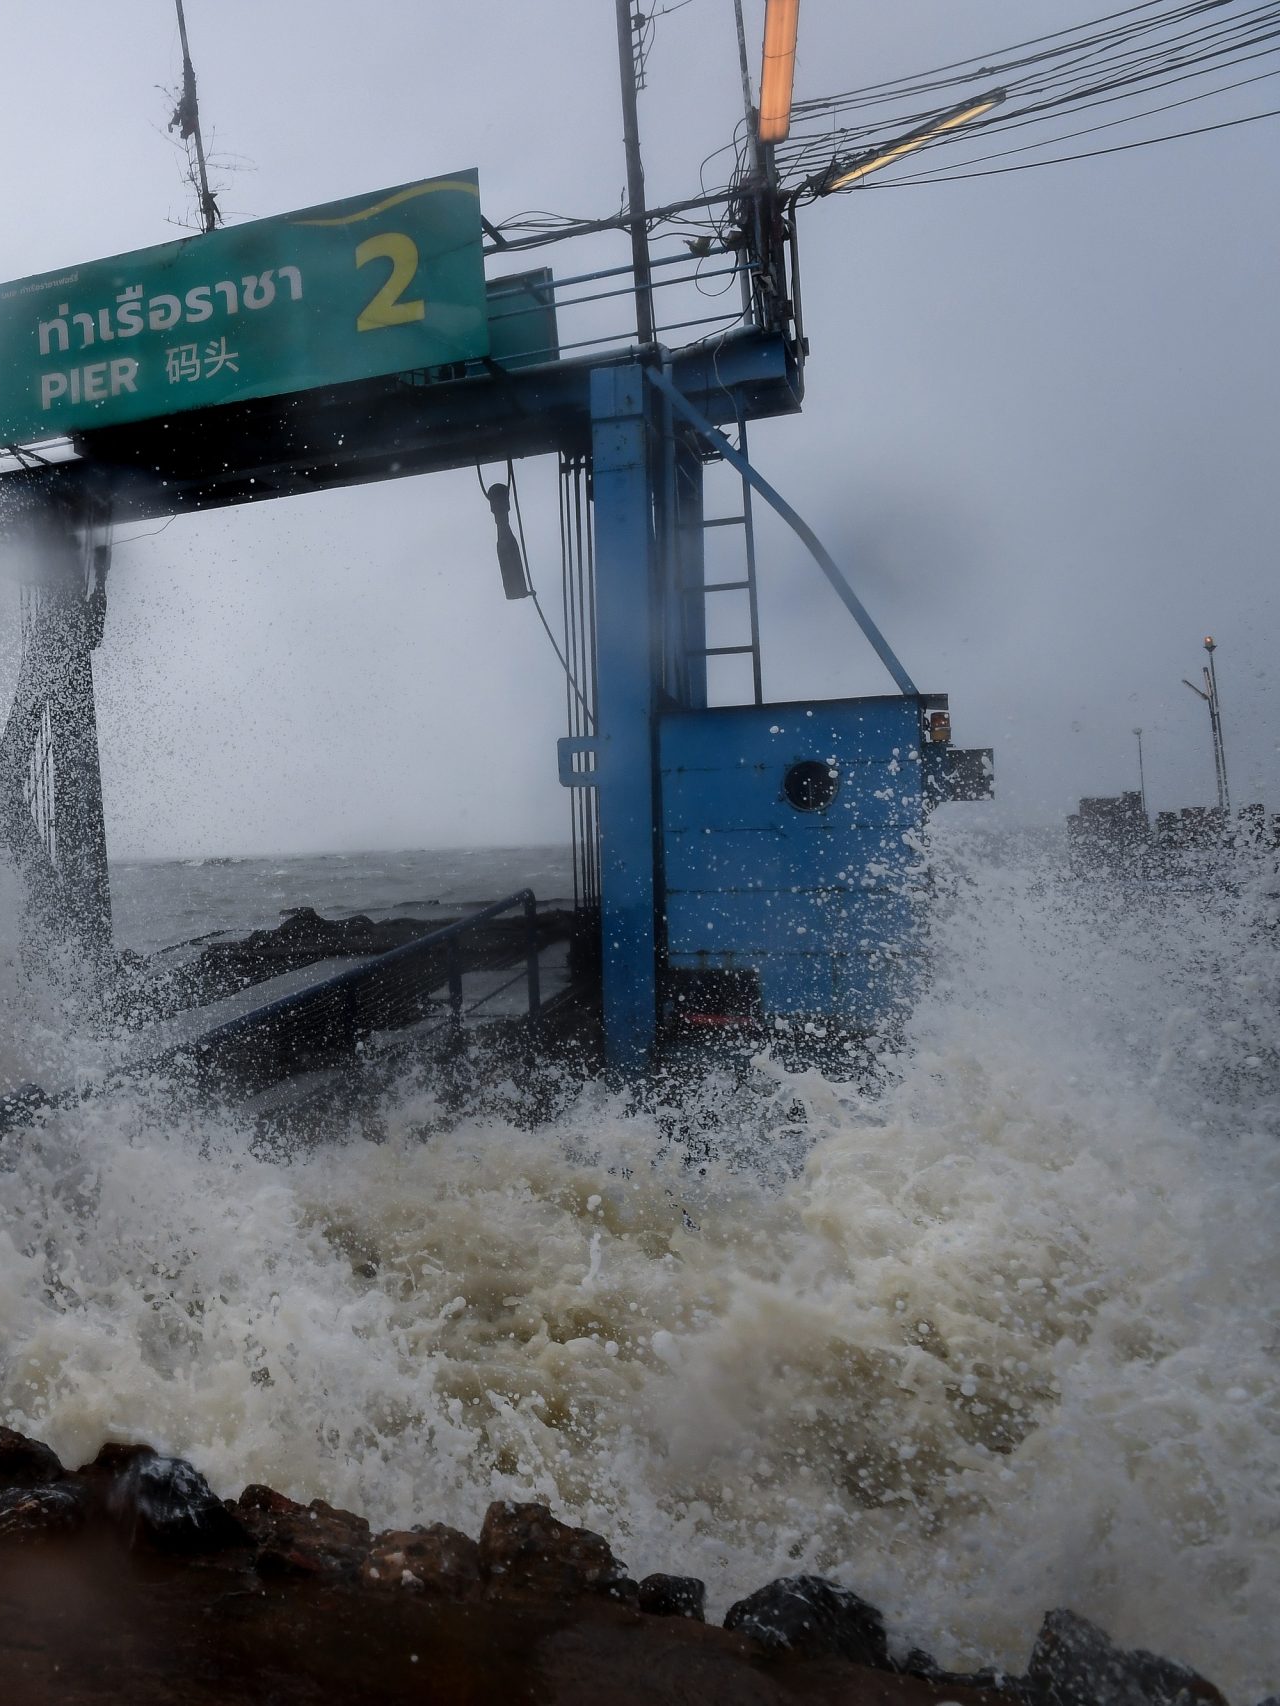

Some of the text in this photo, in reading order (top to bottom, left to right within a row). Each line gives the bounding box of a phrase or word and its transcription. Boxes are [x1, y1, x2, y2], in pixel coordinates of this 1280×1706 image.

[38, 265, 304, 355] ท่าเรือราชา
[355, 233, 425, 332] 2
[40, 357, 138, 410] PIER
[165, 336, 240, 385] 码头
